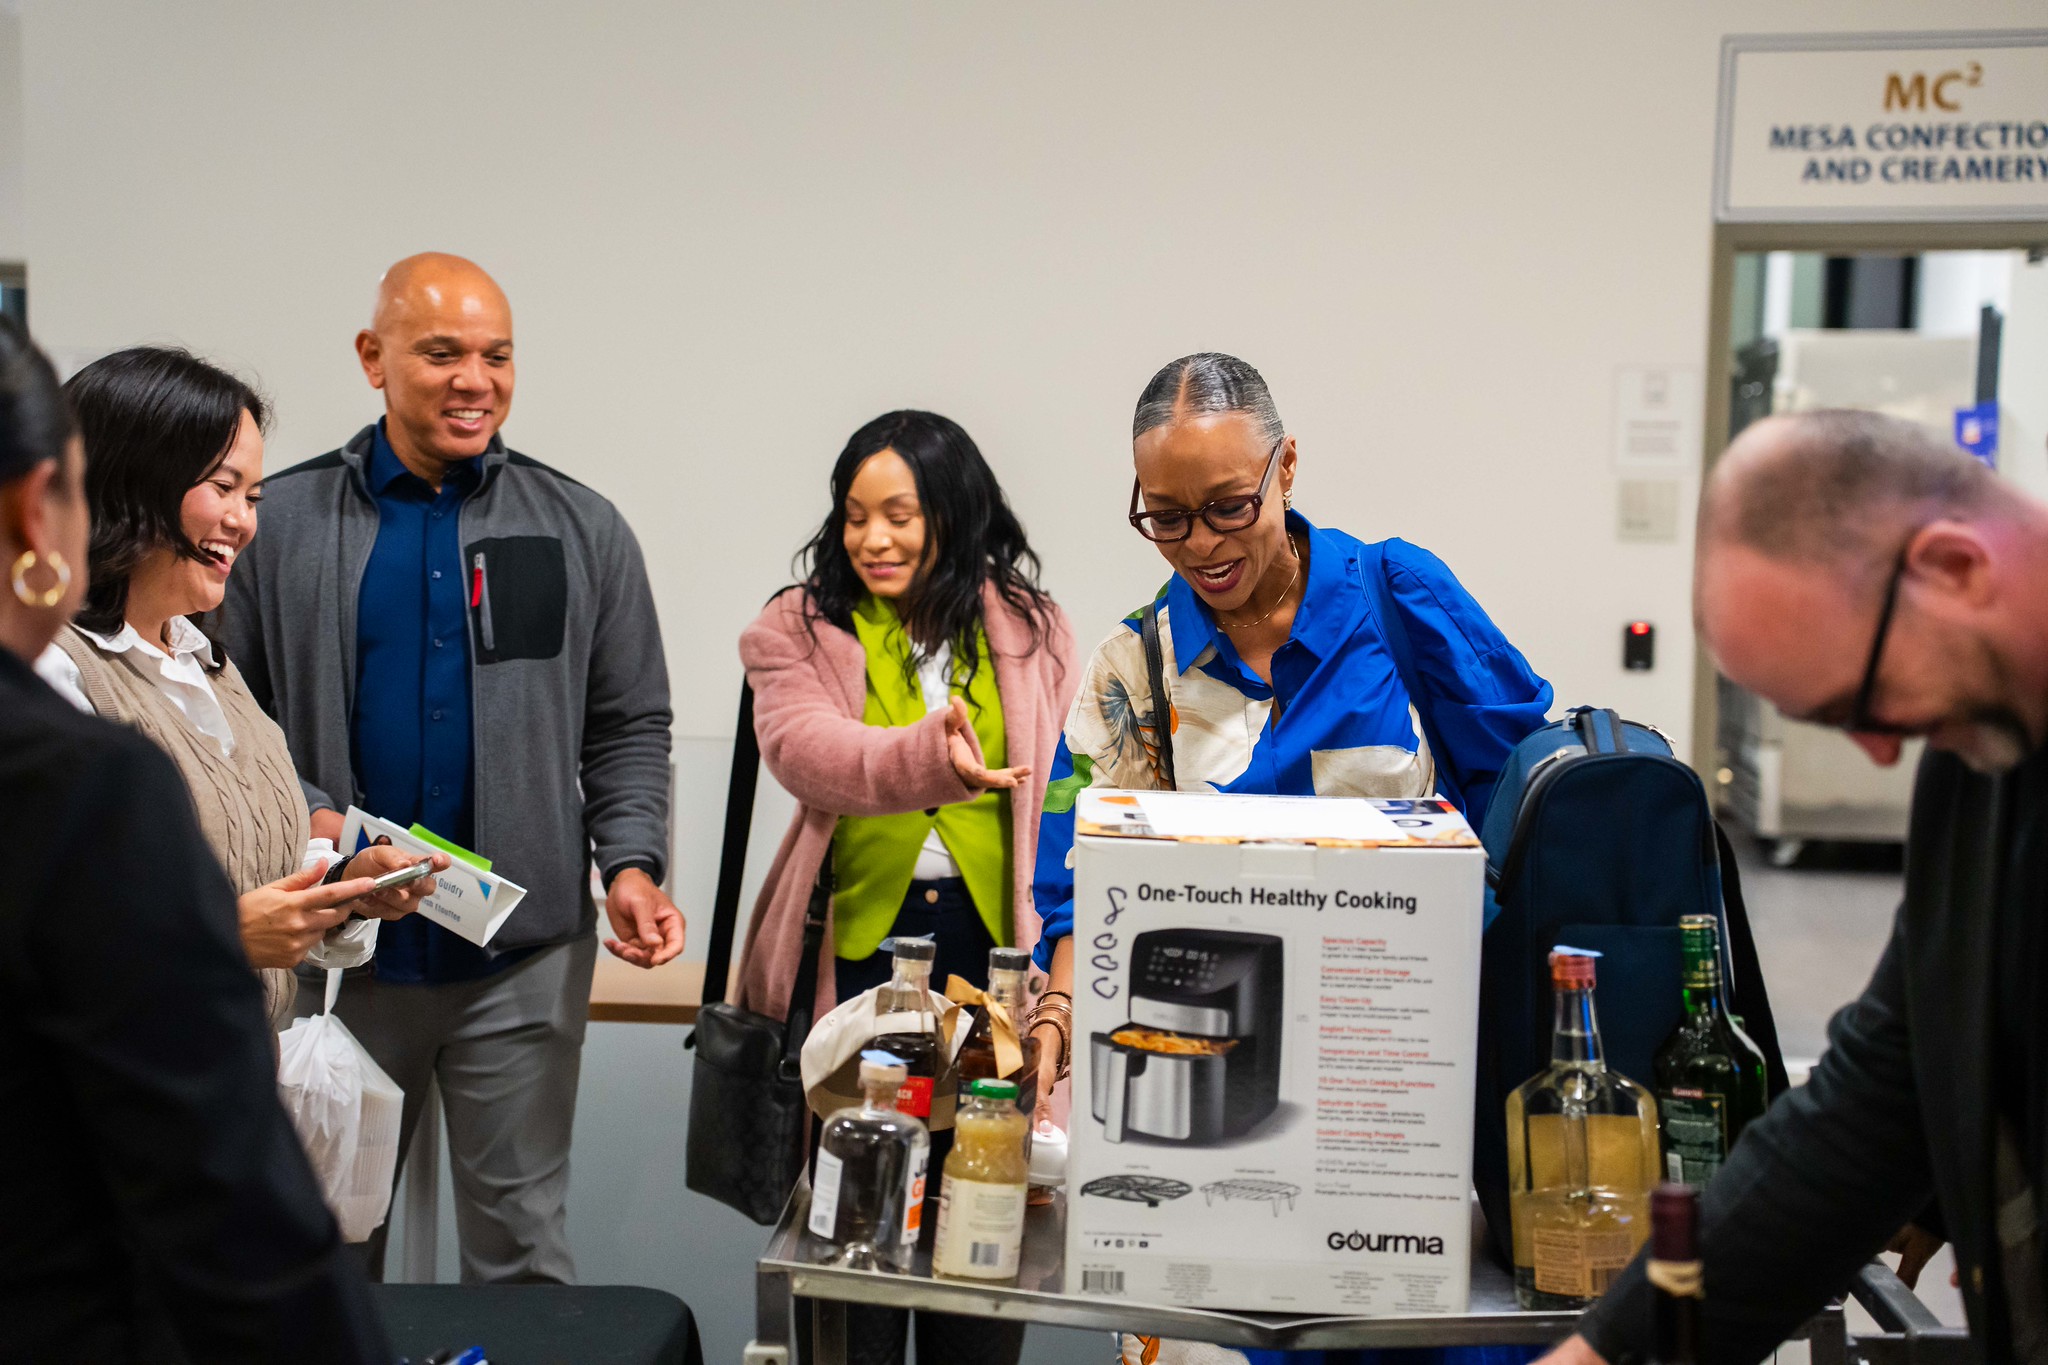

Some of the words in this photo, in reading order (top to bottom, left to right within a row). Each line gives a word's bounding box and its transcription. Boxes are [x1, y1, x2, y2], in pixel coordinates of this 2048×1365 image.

[1770, 124, 1855, 150] MESA
[1803, 157, 1871, 183] AND
[438, 877, 463, 898] Guidry
[1138, 883, 1242, 905] One-Touch
[1250, 887, 1327, 911] Healthy
[1335, 890, 1417, 914] Cooking
[1328, 1229, 1444, 1255] Gourmia
